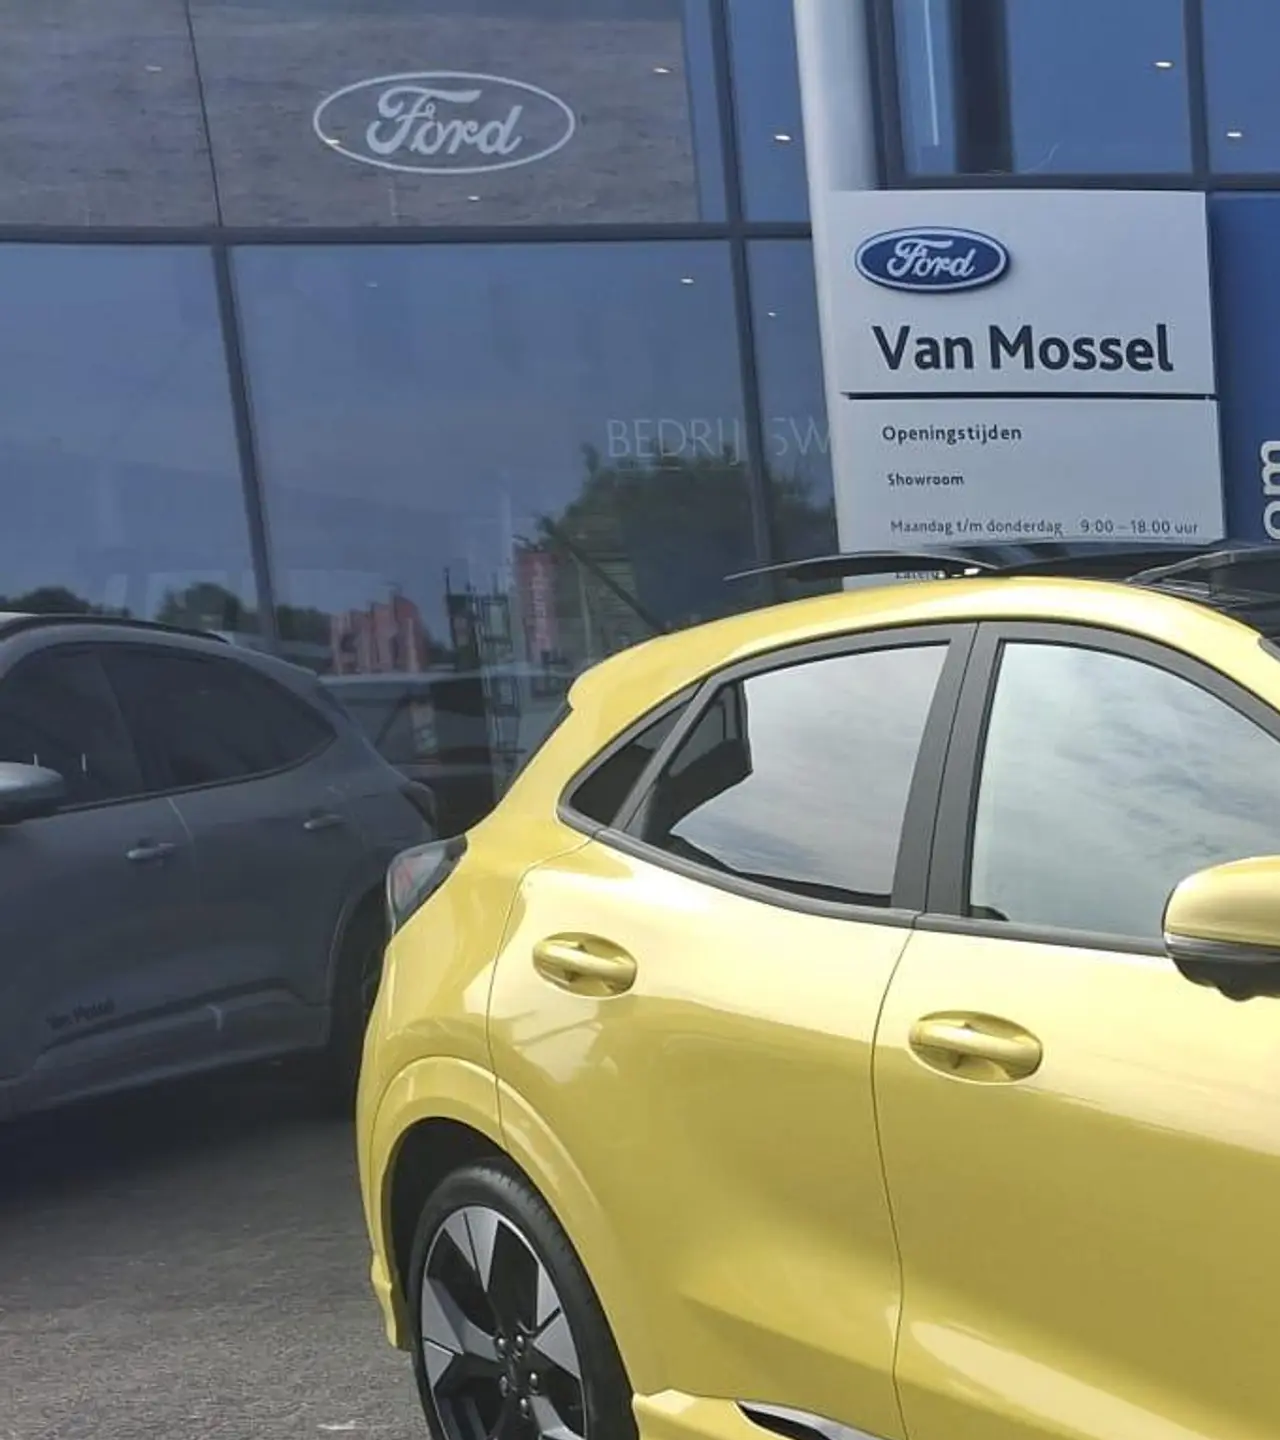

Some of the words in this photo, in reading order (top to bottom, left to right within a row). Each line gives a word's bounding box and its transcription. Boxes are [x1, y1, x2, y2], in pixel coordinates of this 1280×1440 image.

[366, 86, 523, 156] Ford
[886, 232, 977, 279] Ford
[872, 325, 974, 371] Van
[989, 324, 1174, 372] Mossel
[606, 417, 829, 467] BEDRIJSW
[882, 424, 1023, 445] Openingstijden
[886, 472, 965, 487] Showroom
[890, 519, 954, 536] Maandag
[956, 518, 983, 533] t/m
[986, 518, 1064, 539] donderdag
[1174, 522, 1199, 535] uur
